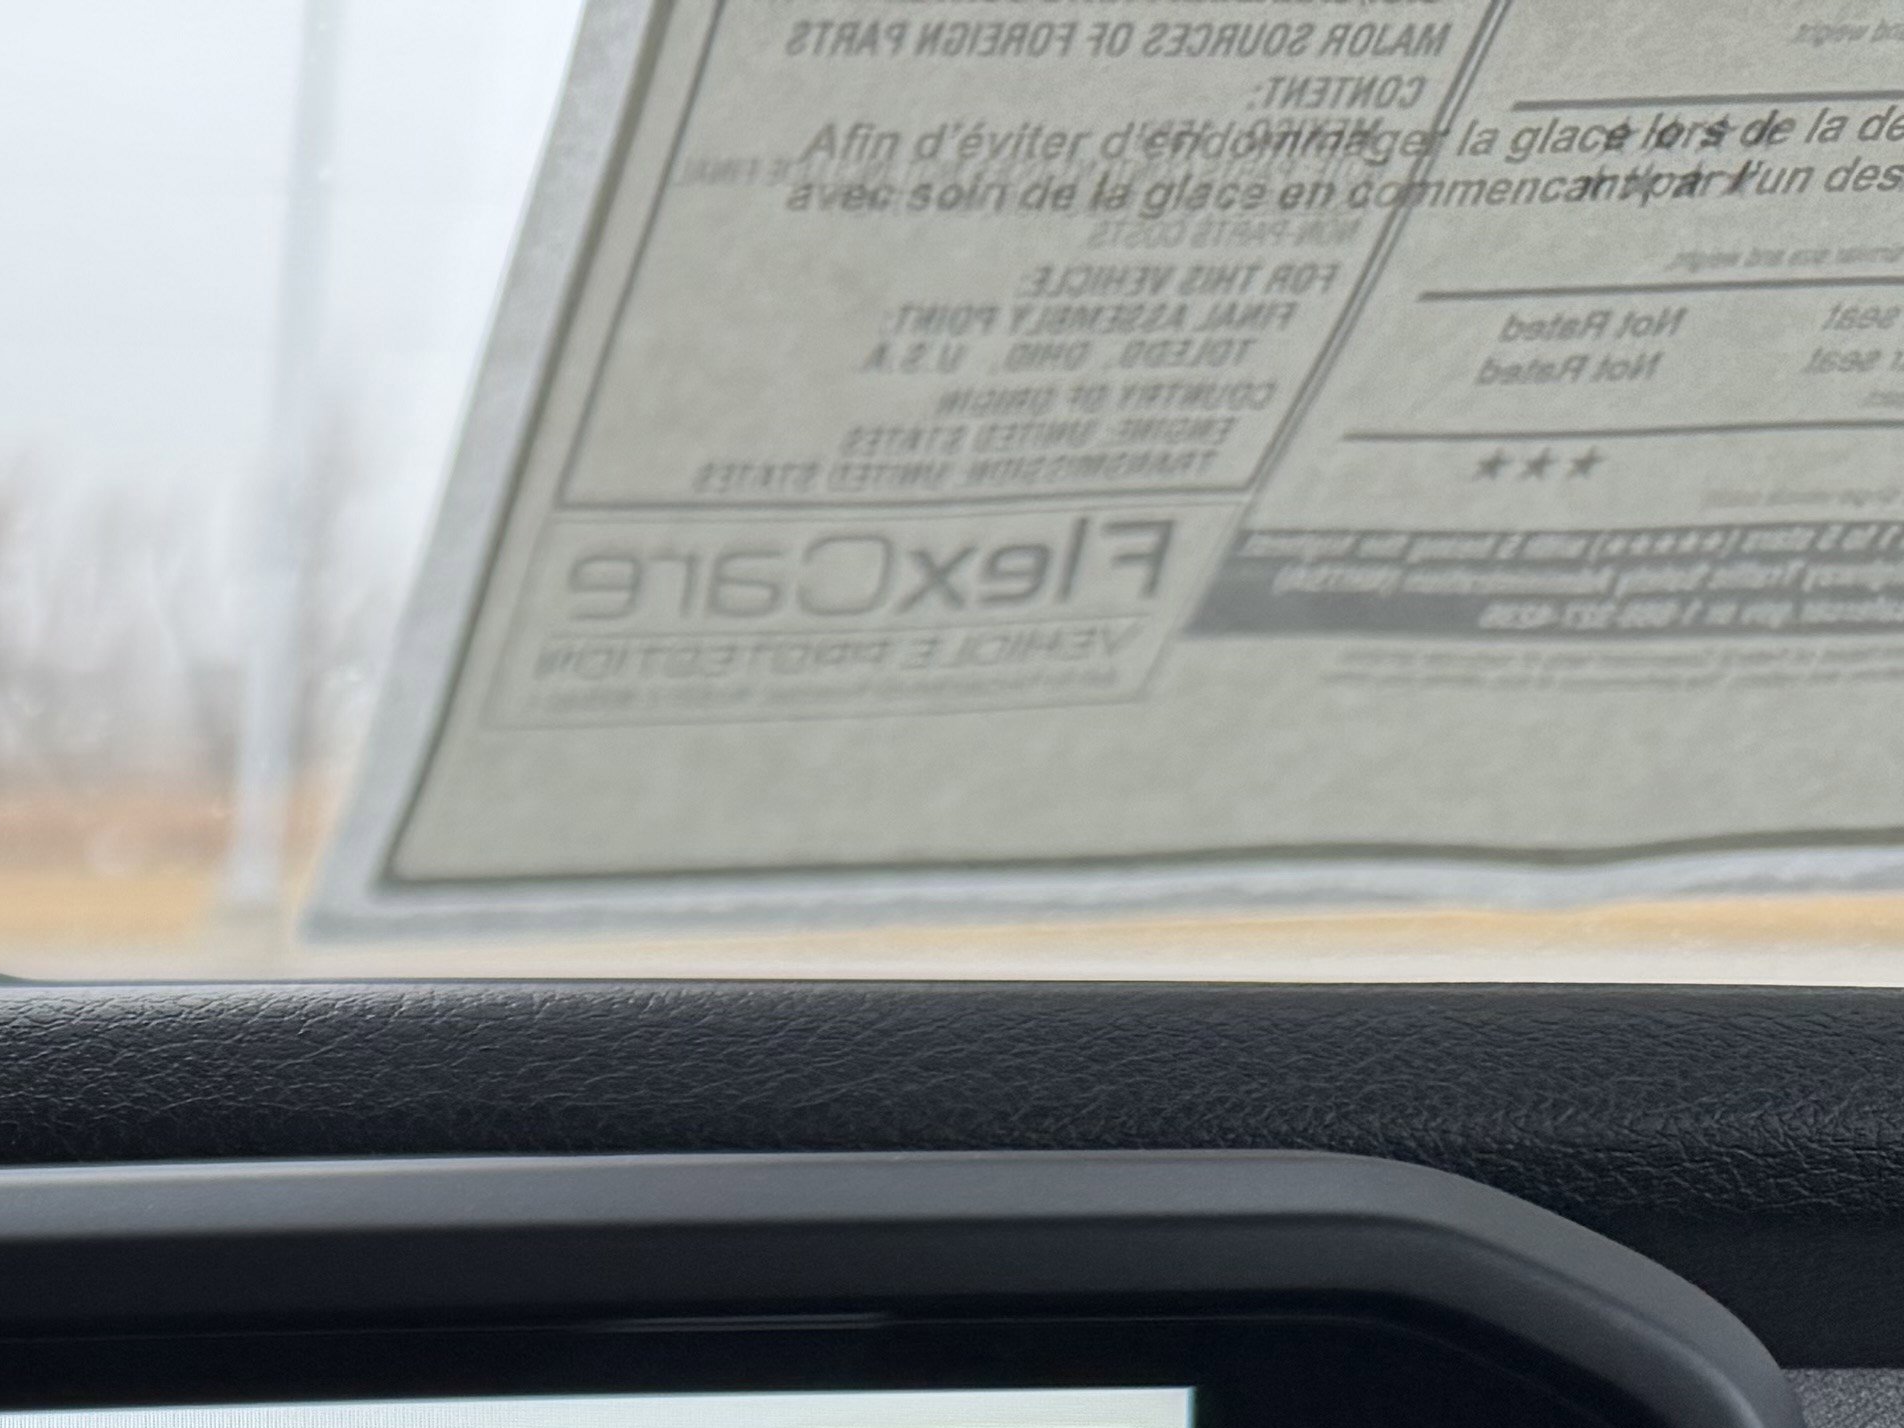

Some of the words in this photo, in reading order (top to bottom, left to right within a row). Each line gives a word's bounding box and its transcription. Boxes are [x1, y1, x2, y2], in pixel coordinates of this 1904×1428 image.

[799, 121, 901, 162] Afin
[1457, 118, 1499, 157] la
[1505, 115, 1630, 165] glace
[1642, 112, 1729, 149] lors
[1740, 109, 1796, 147] de
[1804, 107, 1849, 143] la
[785, 180, 894, 213] avec
[912, 177, 1009, 212] soin
[1023, 173, 1083, 210] de
[1089, 170, 1131, 211] la
[1139, 173, 1267, 219] glace
[1279, 181, 1336, 210] en
[1639, 168, 1729, 208] par
[1824, 156, 1904, 192] des
